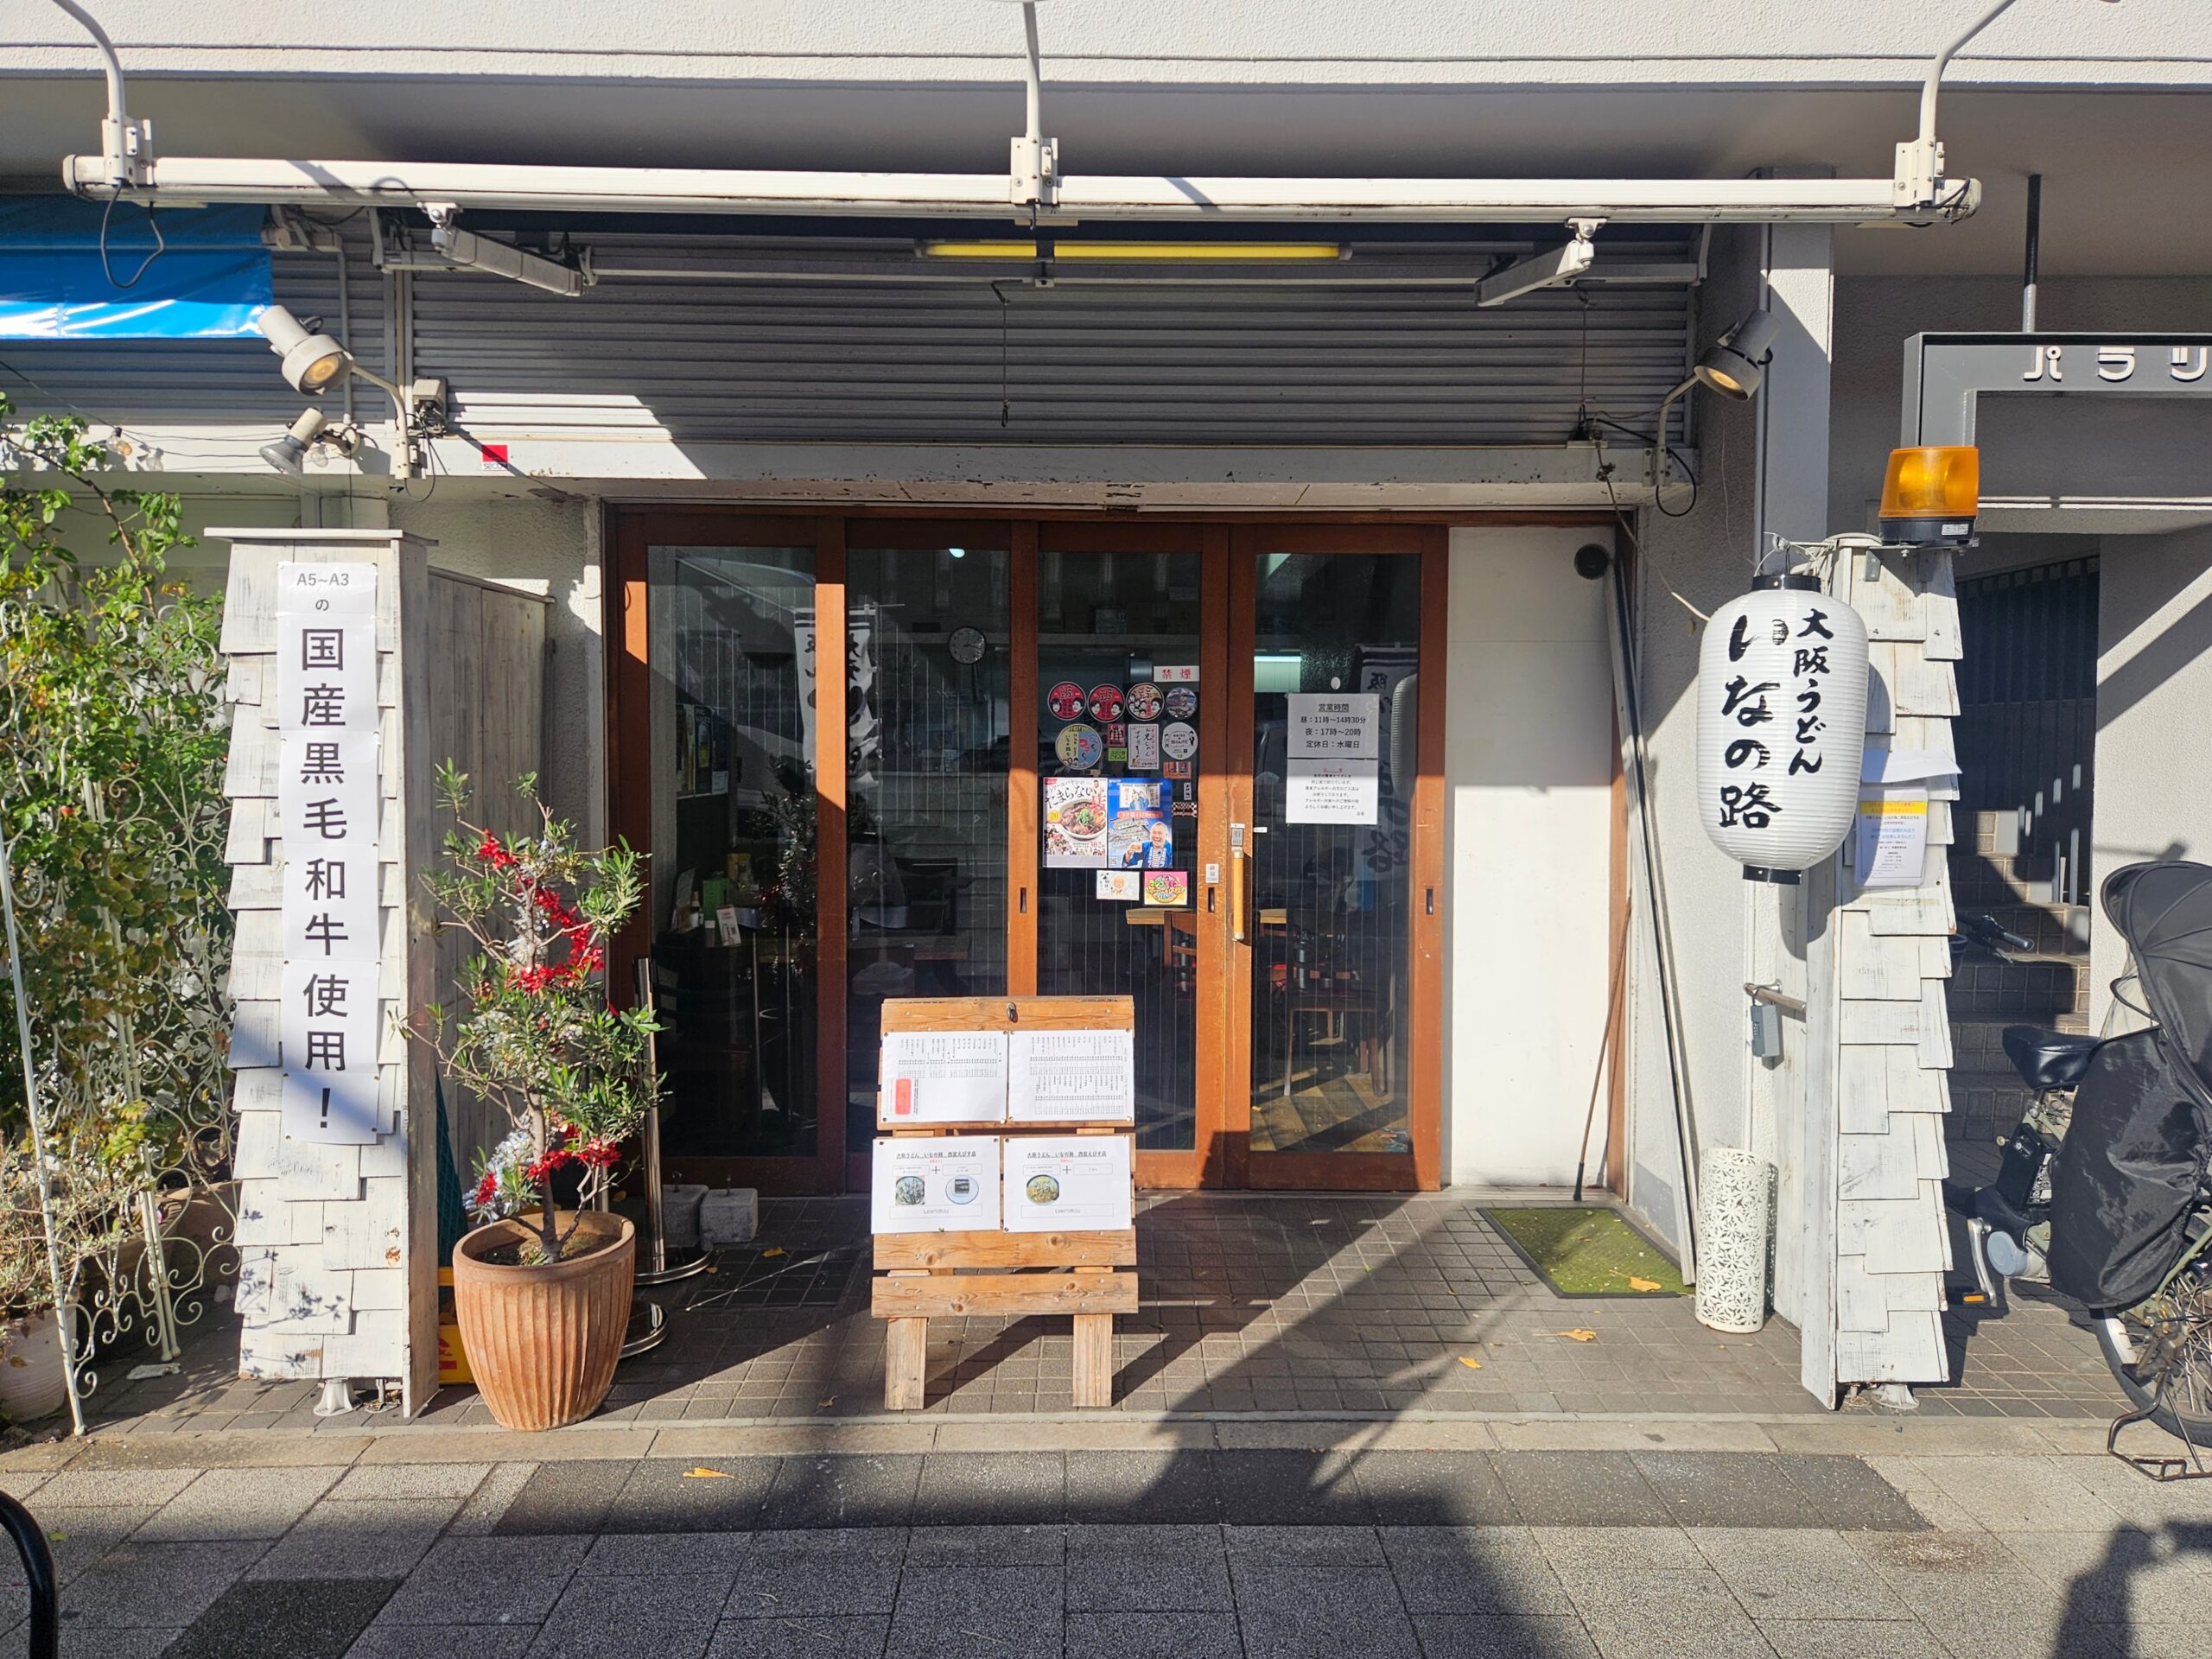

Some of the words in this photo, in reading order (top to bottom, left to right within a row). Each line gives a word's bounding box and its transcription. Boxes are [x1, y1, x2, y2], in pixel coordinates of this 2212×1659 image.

[315, 599, 329, 611] の
[1318, 703, 1350, 713] 営業時間
[1718, 614, 1789, 830] いなの路
[1788, 608, 1834, 776] 大阪うどん
